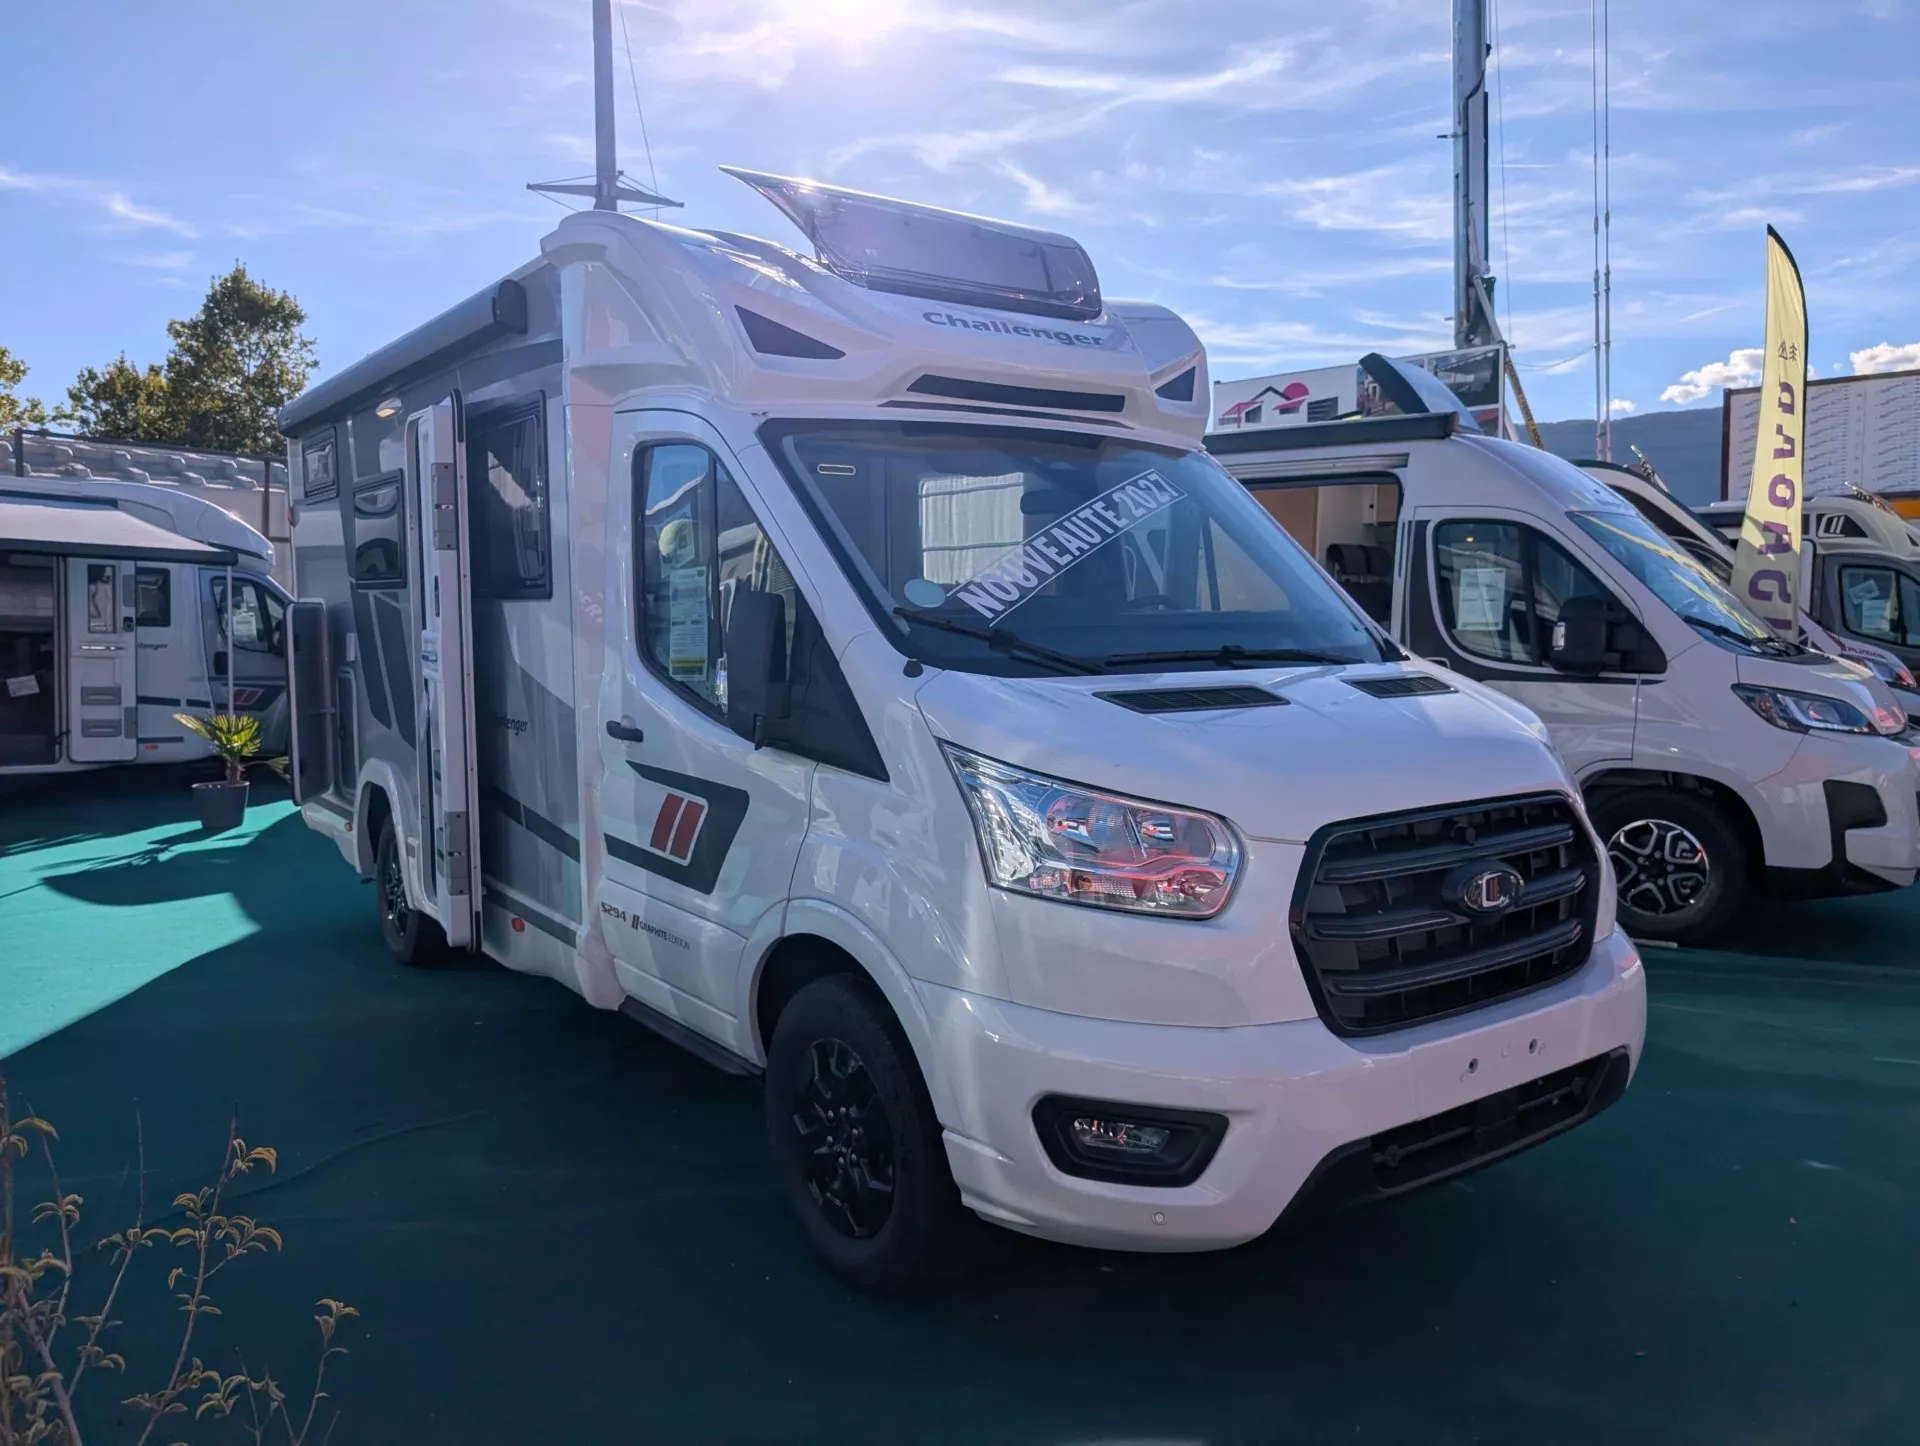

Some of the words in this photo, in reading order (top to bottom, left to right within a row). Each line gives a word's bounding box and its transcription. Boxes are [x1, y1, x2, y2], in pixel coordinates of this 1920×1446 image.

[922, 311, 1105, 346] Challenger
[956, 500, 1130, 619] NOUVEAUTE
[1111, 472, 1179, 518] 2027
[639, 921, 669, 941] GRAPHITE
[667, 932, 691, 952] EDITION
